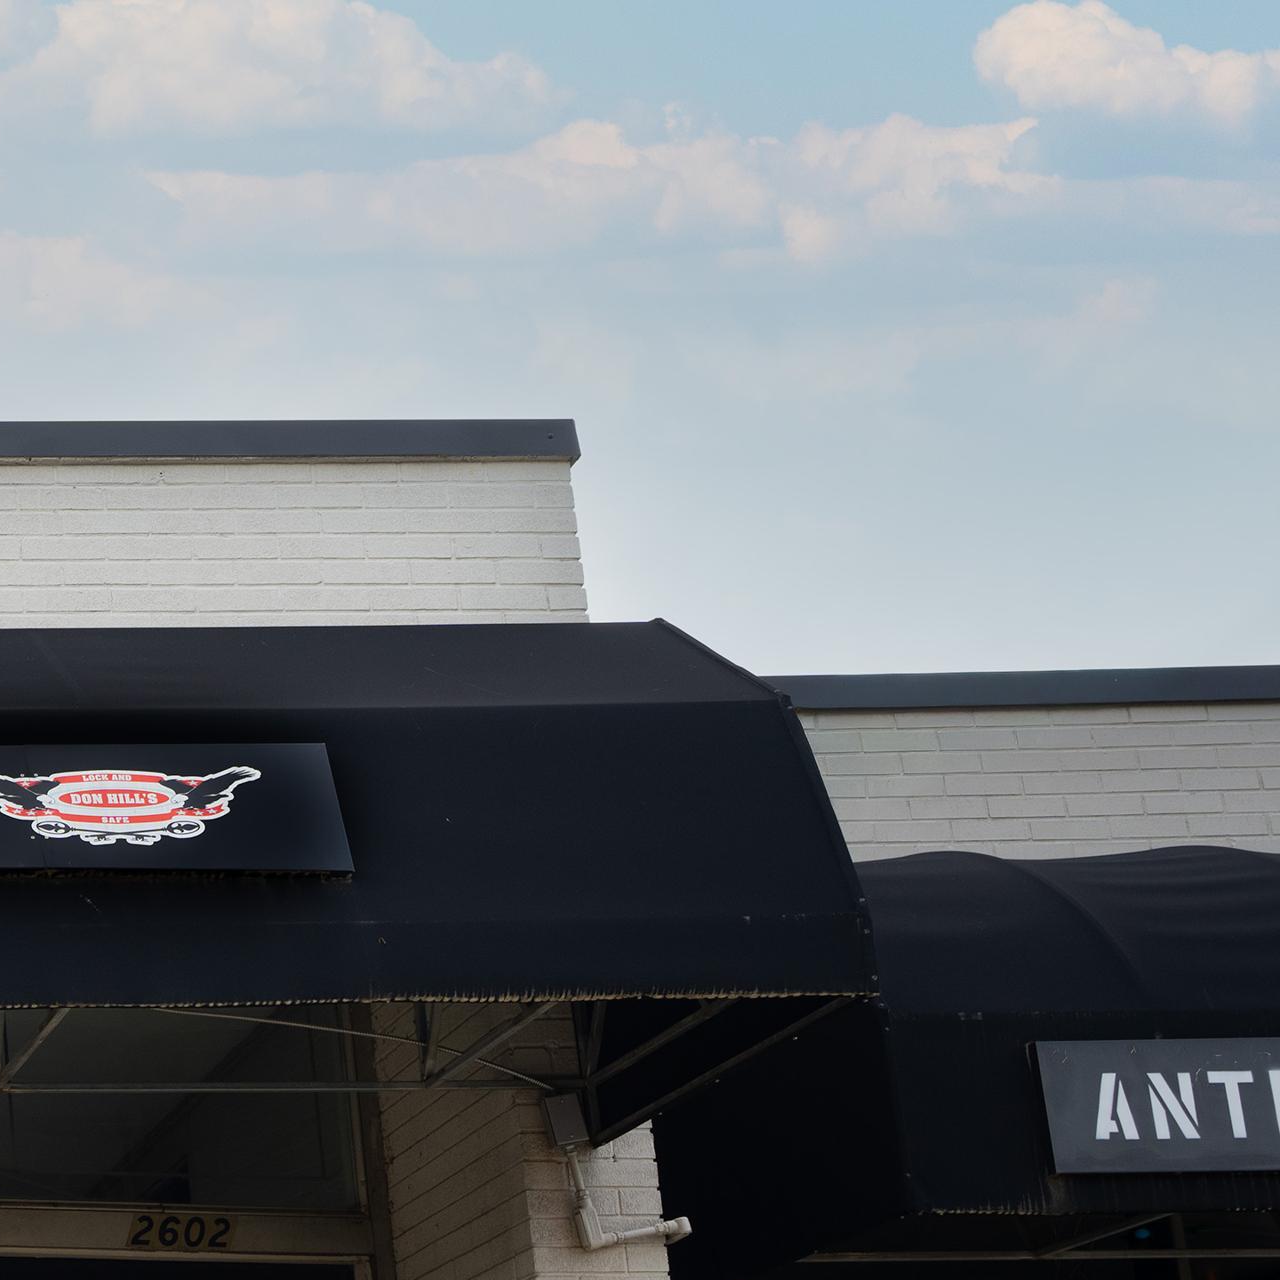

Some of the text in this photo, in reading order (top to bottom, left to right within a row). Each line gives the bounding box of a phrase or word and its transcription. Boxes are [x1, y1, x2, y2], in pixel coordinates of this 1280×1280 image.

[82, 774, 133, 782] LOCK AND
[69, 793, 159, 805] DON HILL'S
[101, 816, 130, 824] SAFE
[130, 1215, 231, 1248] 2602
